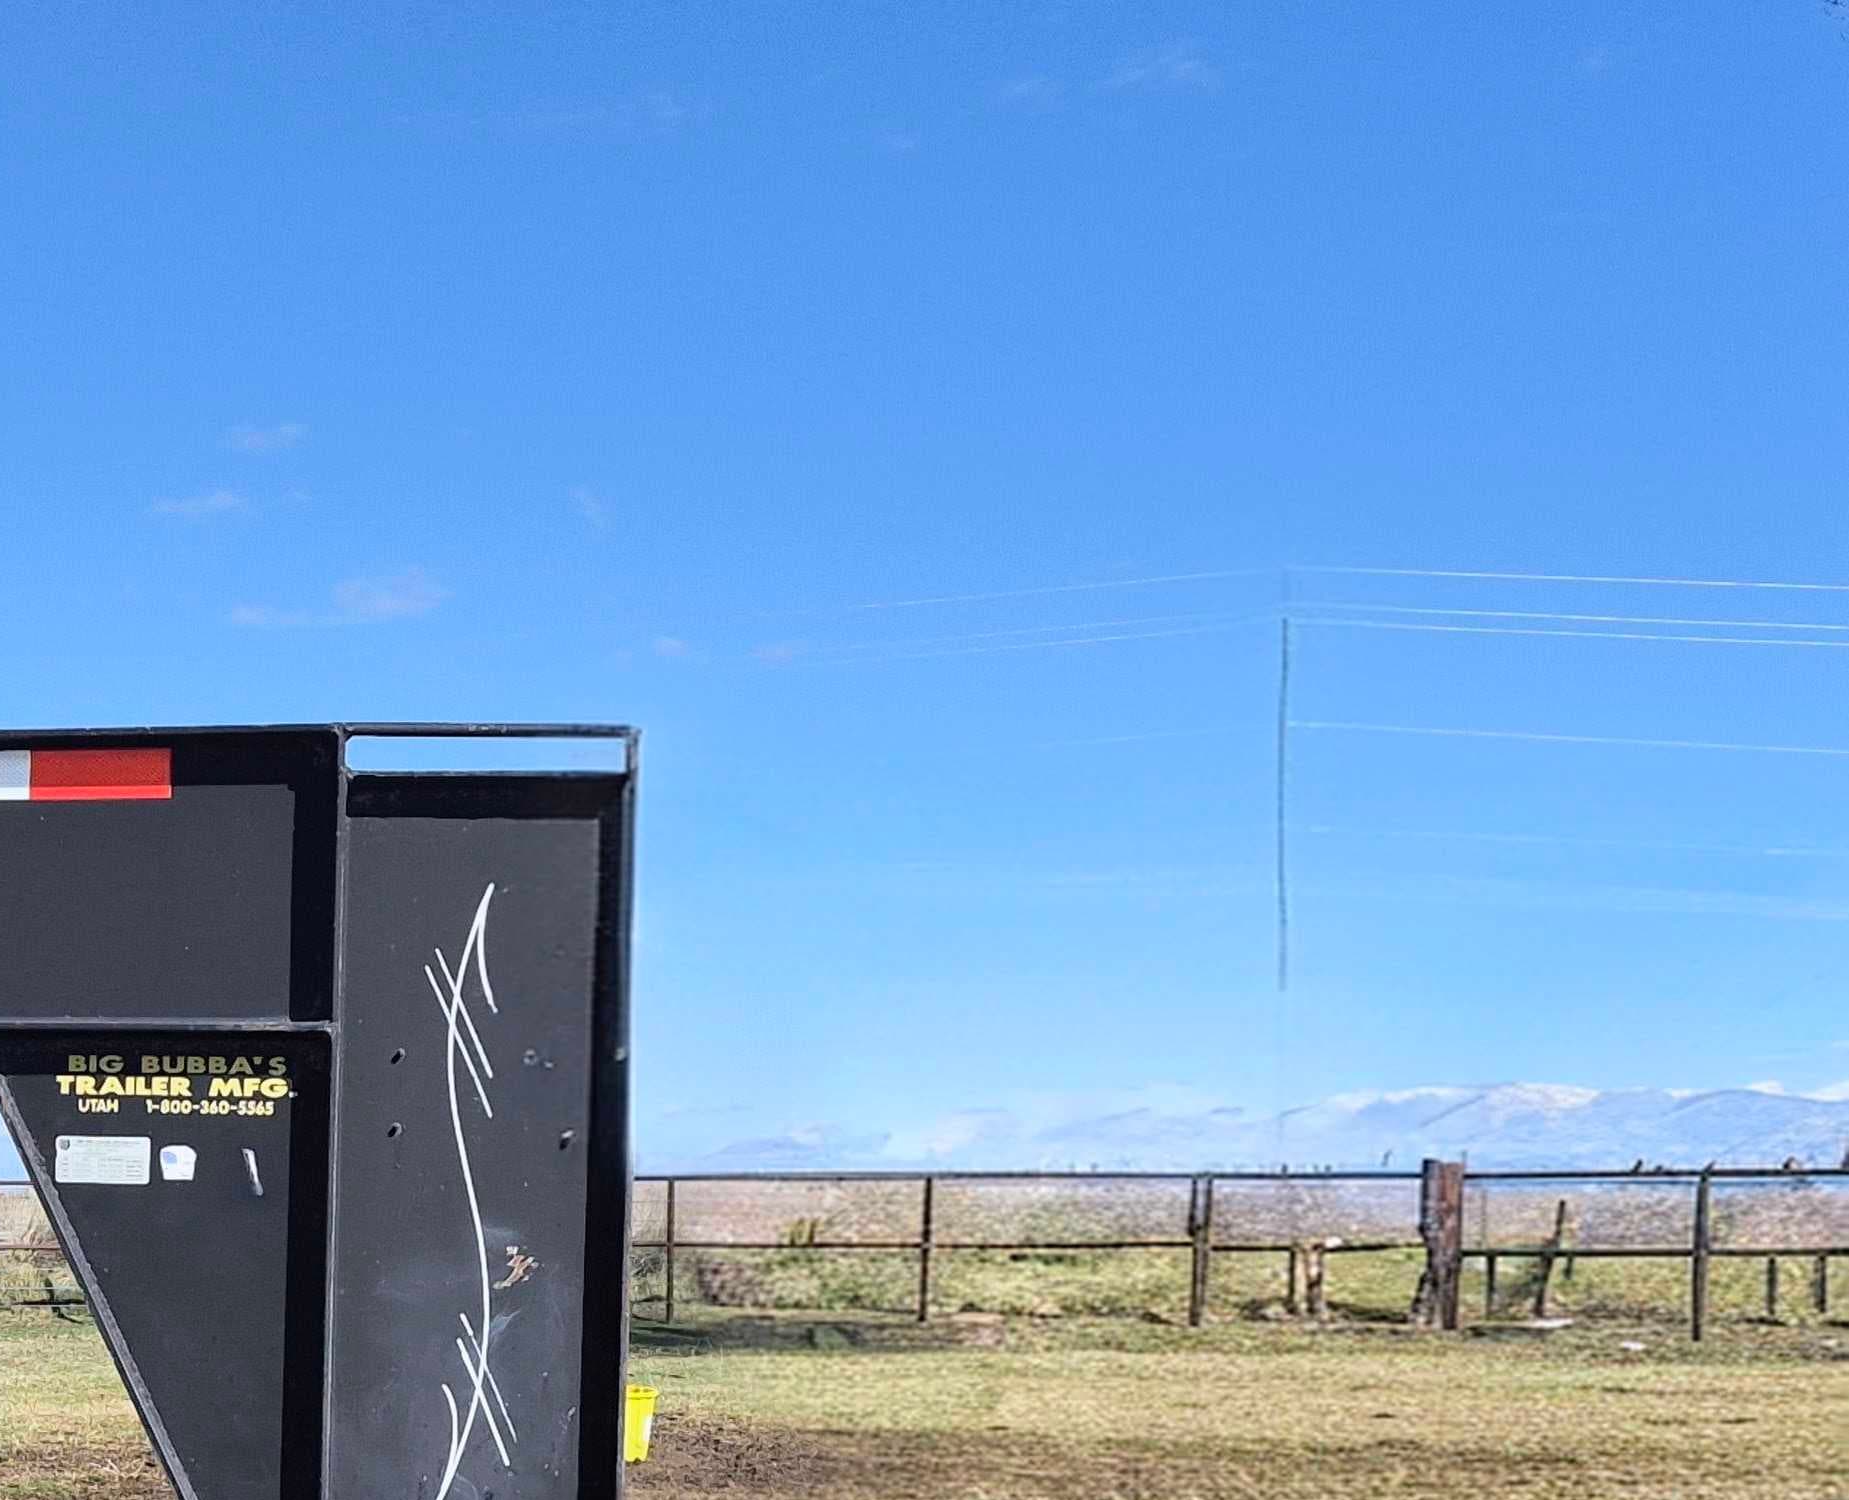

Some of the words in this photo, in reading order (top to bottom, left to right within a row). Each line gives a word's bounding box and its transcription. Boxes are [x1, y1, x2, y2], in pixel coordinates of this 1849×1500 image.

[67, 1054, 124, 1073] BIG
[141, 1055, 287, 1076] BUBBA'S
[55, 1075, 193, 1097] TRAILER
[77, 1098, 120, 1114] UTAH
[145, 1099, 275, 1117] 1-800-360-5565
